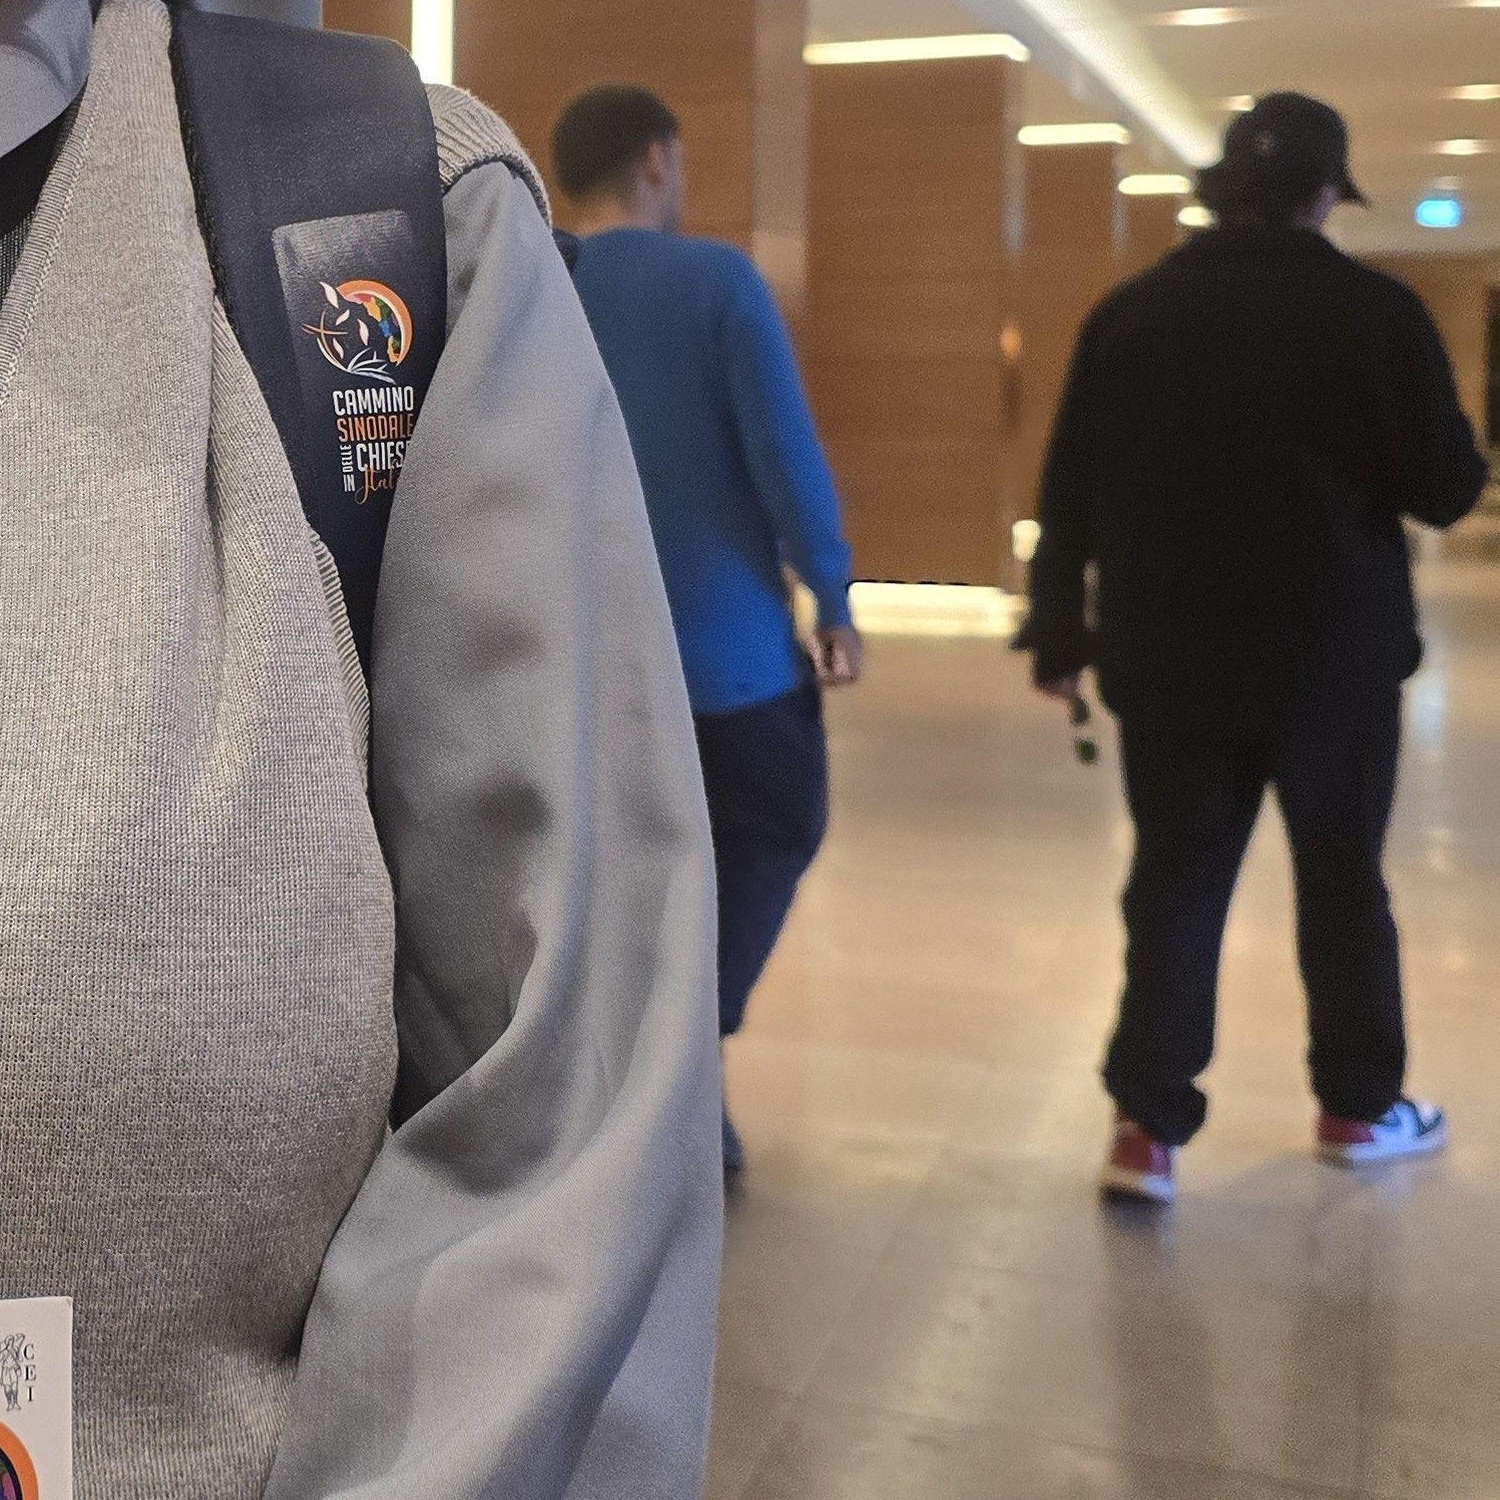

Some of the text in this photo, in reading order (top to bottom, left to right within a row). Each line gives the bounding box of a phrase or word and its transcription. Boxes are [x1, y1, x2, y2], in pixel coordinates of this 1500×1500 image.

[332, 386, 414, 416] CAMMINO
[336, 413, 414, 443] SINODALE
[340, 441, 407, 473] DELLE CHIES
[343, 474, 356, 493] IN
[22, 1343, 37, 1402] CEI
